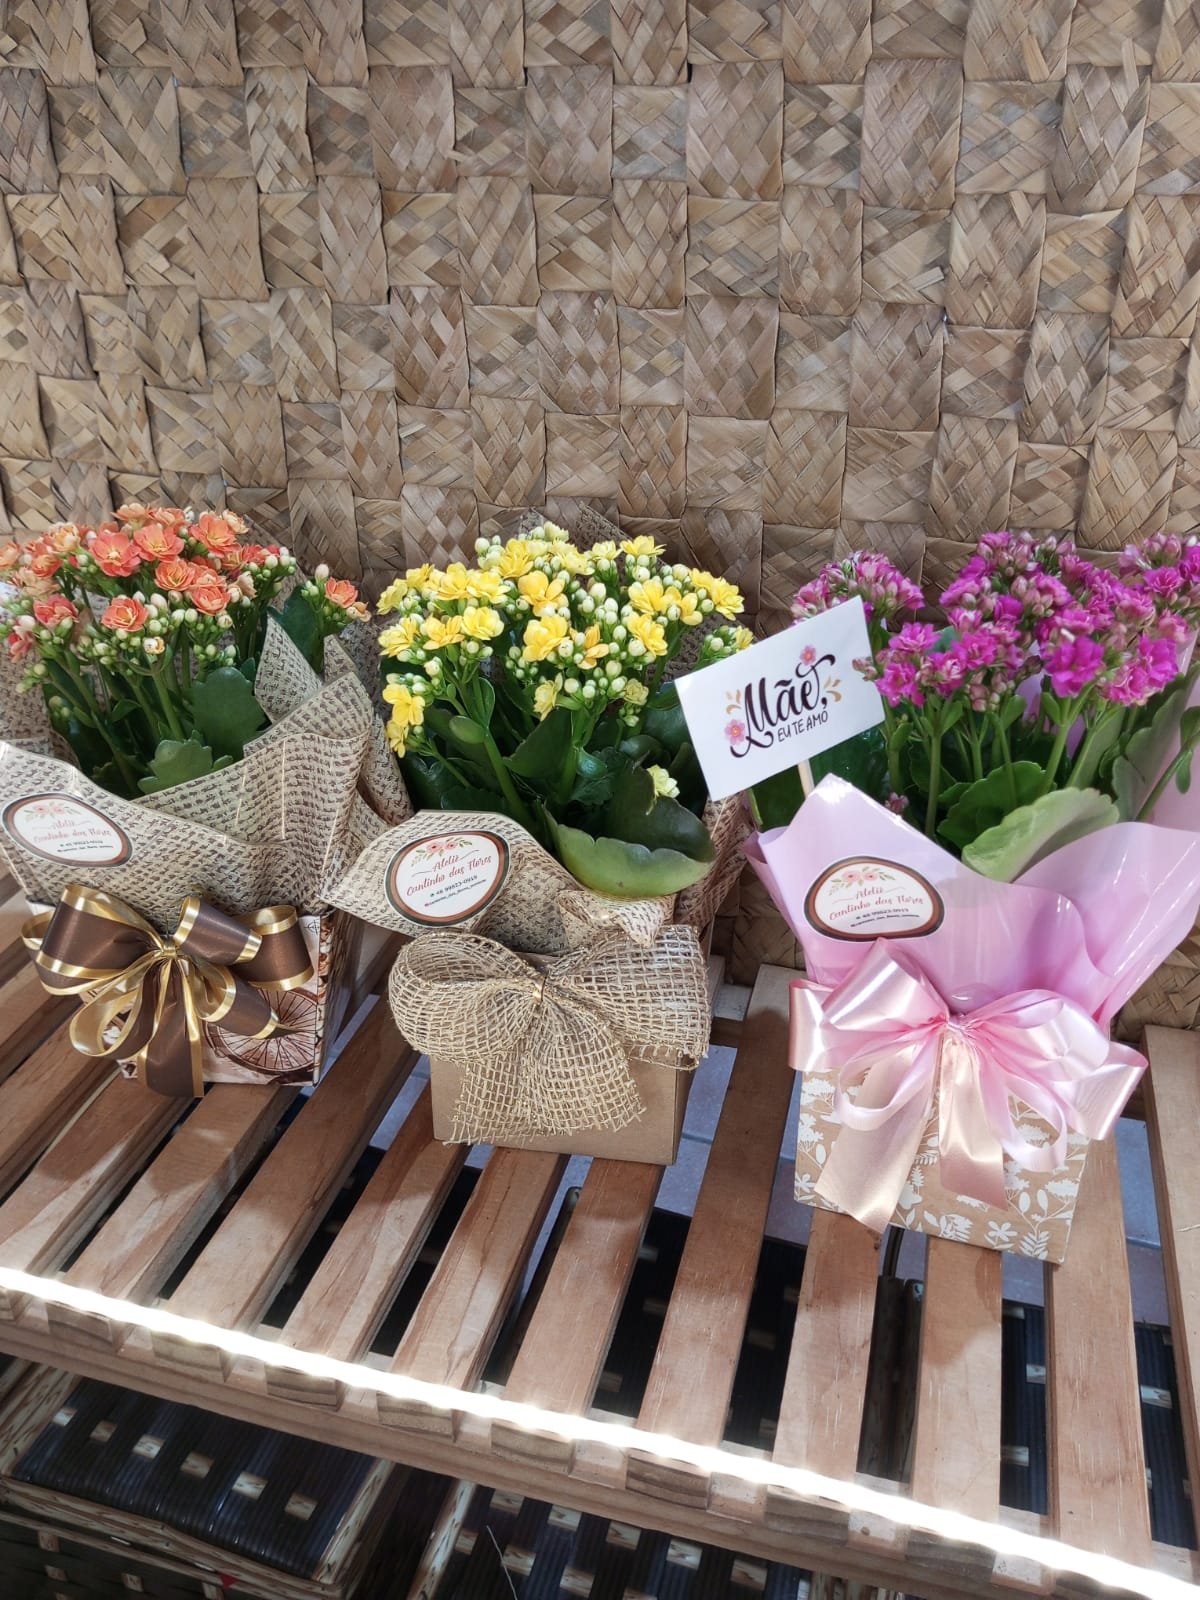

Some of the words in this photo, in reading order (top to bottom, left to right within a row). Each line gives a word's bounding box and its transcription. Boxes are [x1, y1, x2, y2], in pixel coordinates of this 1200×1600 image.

[777, 726, 792, 743] EU
[791, 719, 805, 735] TE
[806, 709, 829, 732] AMO
[406, 871, 445, 896] Cantinho
[449, 865, 465, 878] das
[468, 855, 492, 871] Flores
[829, 900, 871, 921] Cantinho
[875, 896, 892, 905] das
